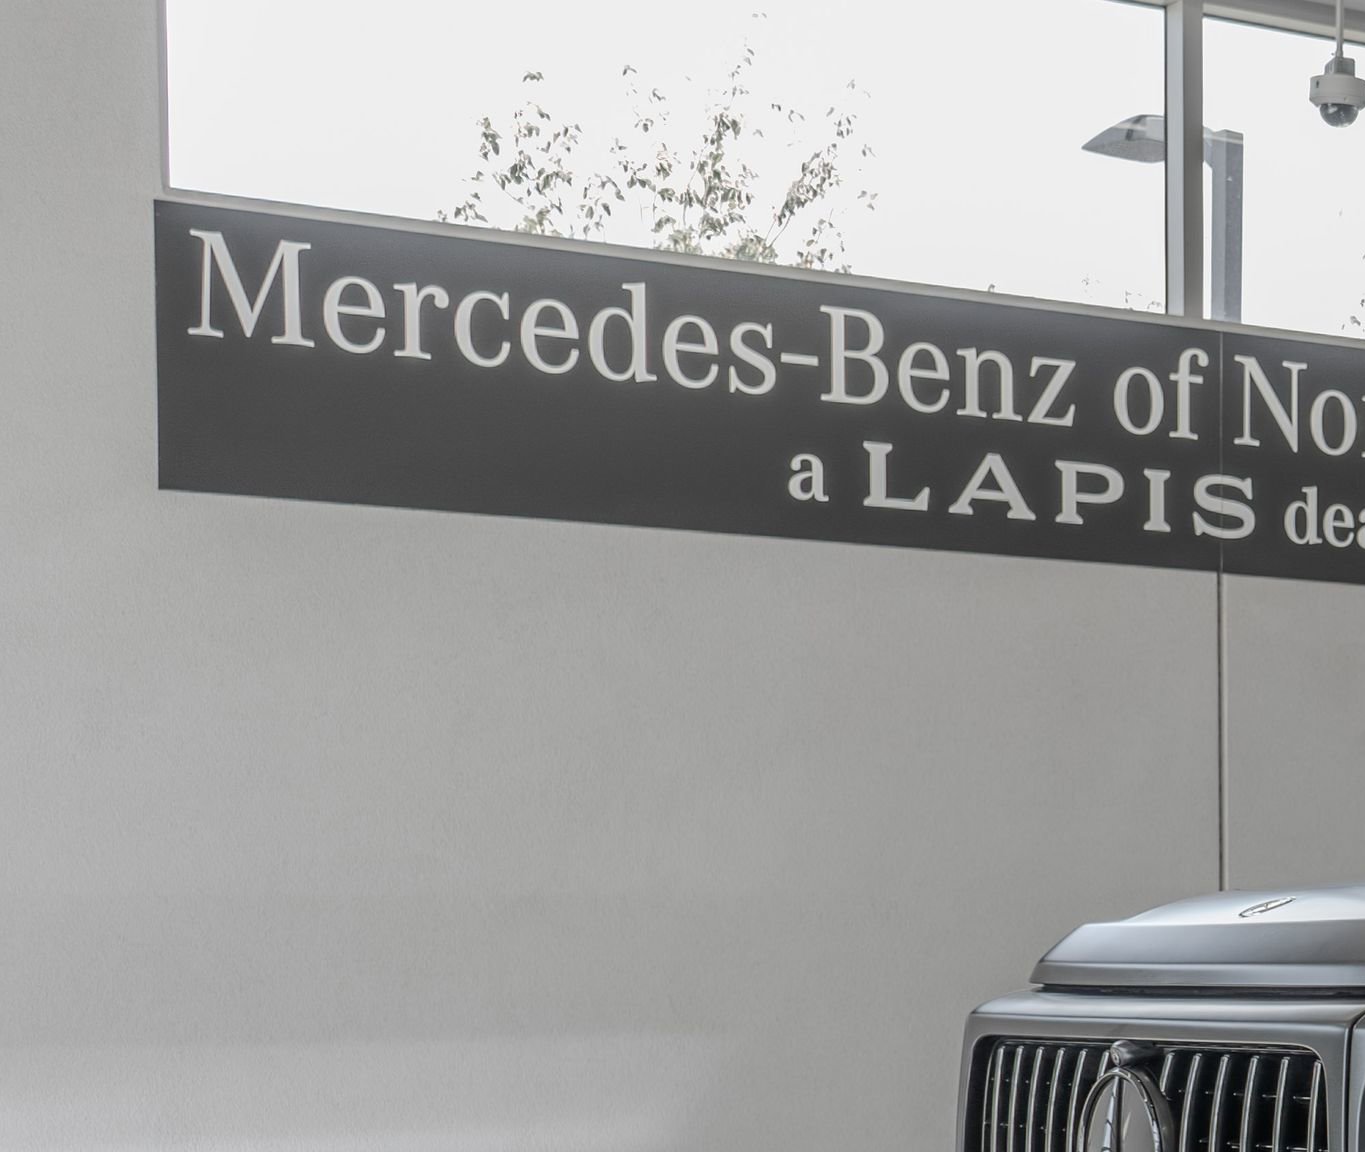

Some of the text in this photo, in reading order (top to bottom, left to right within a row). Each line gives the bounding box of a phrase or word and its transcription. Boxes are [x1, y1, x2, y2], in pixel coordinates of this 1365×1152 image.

[187, 229, 1077, 427] Mercedes-Benz
[1113, 347, 1210, 441] of
[788, 453, 830, 502] a
[862, 440, 1256, 539] LAPIS
